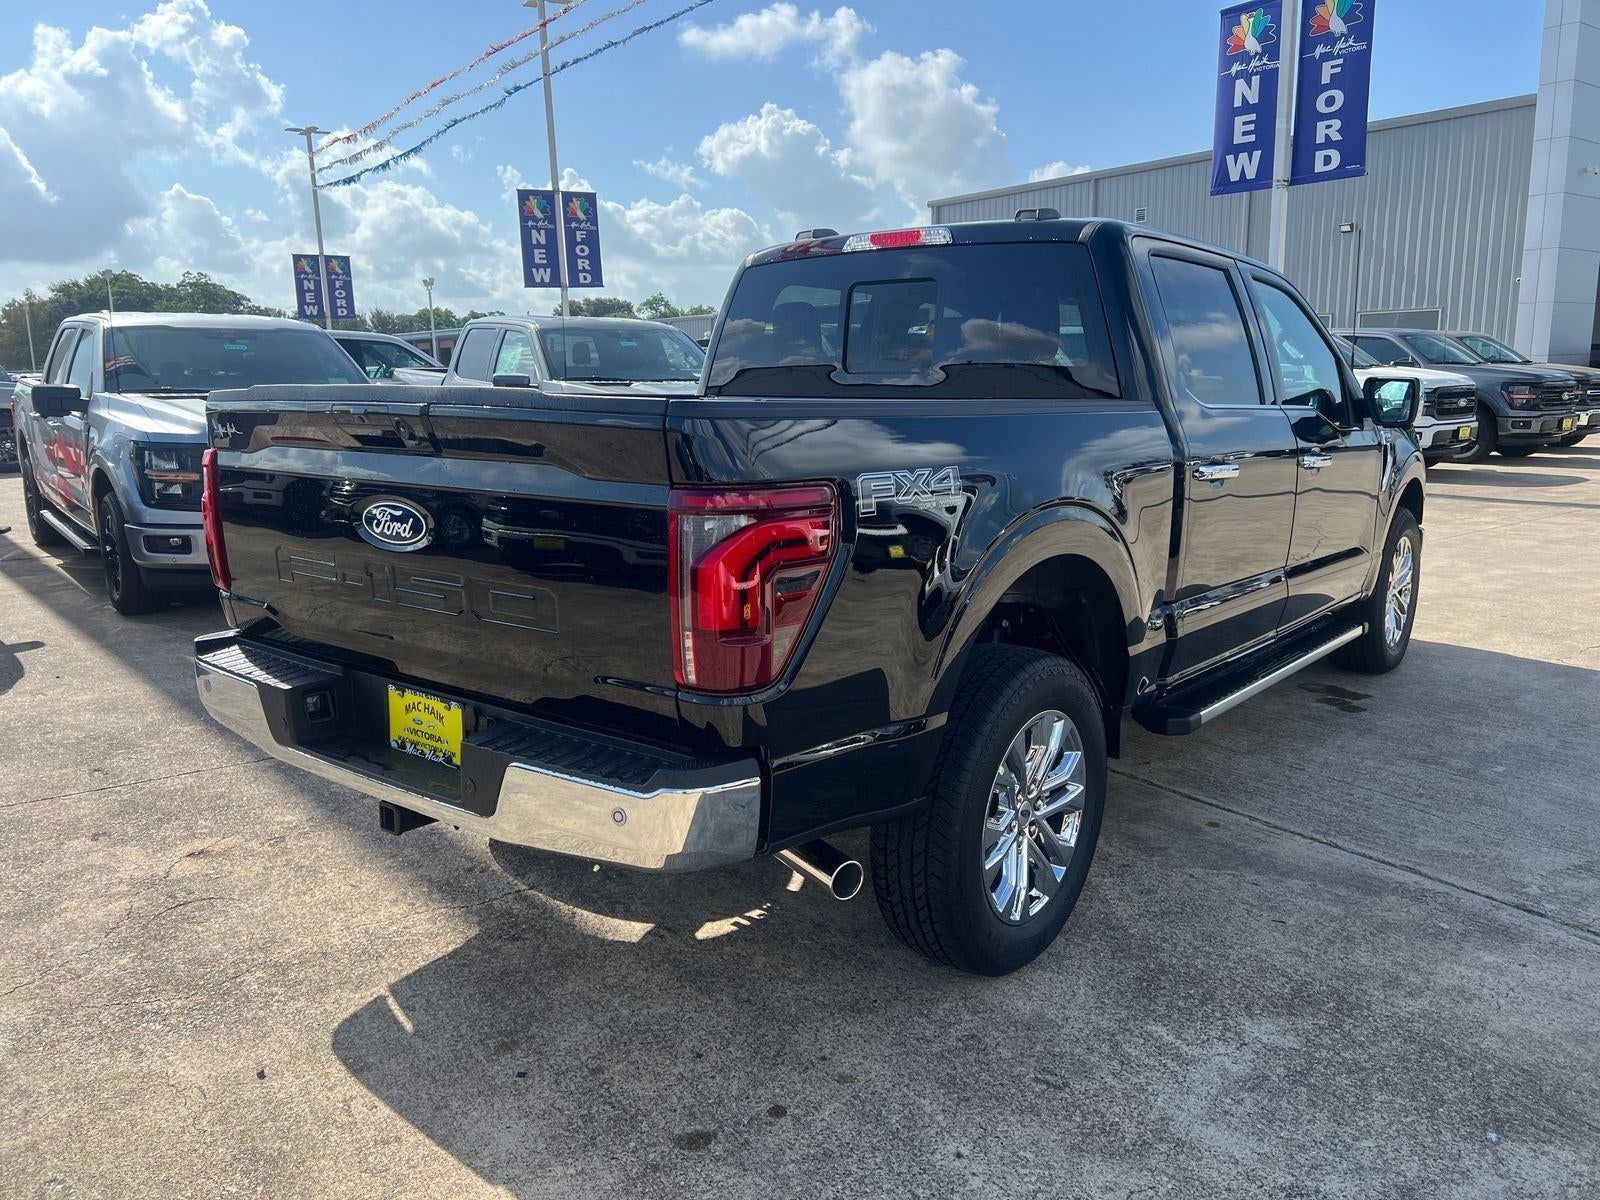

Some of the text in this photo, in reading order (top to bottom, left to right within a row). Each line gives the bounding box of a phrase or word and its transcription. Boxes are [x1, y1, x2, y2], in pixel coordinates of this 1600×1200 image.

[1253, 62, 1280, 72] VICTORIA
[1338, 44, 1367, 55] VICTORIA
[1226, 75, 1261, 182] NEW
[1314, 58, 1345, 173] FORD
[531, 229, 551, 283] NEW
[575, 230, 592, 284] FORD
[303, 279, 318, 316] NEW
[334, 280, 348, 316] FORD
[857, 465, 962, 517] FX4
[373, 506, 413, 538] Ford
[275, 545, 560, 634] F-150
[405, 701, 422, 716] MAC
[423, 702, 446, 727] HAIK
